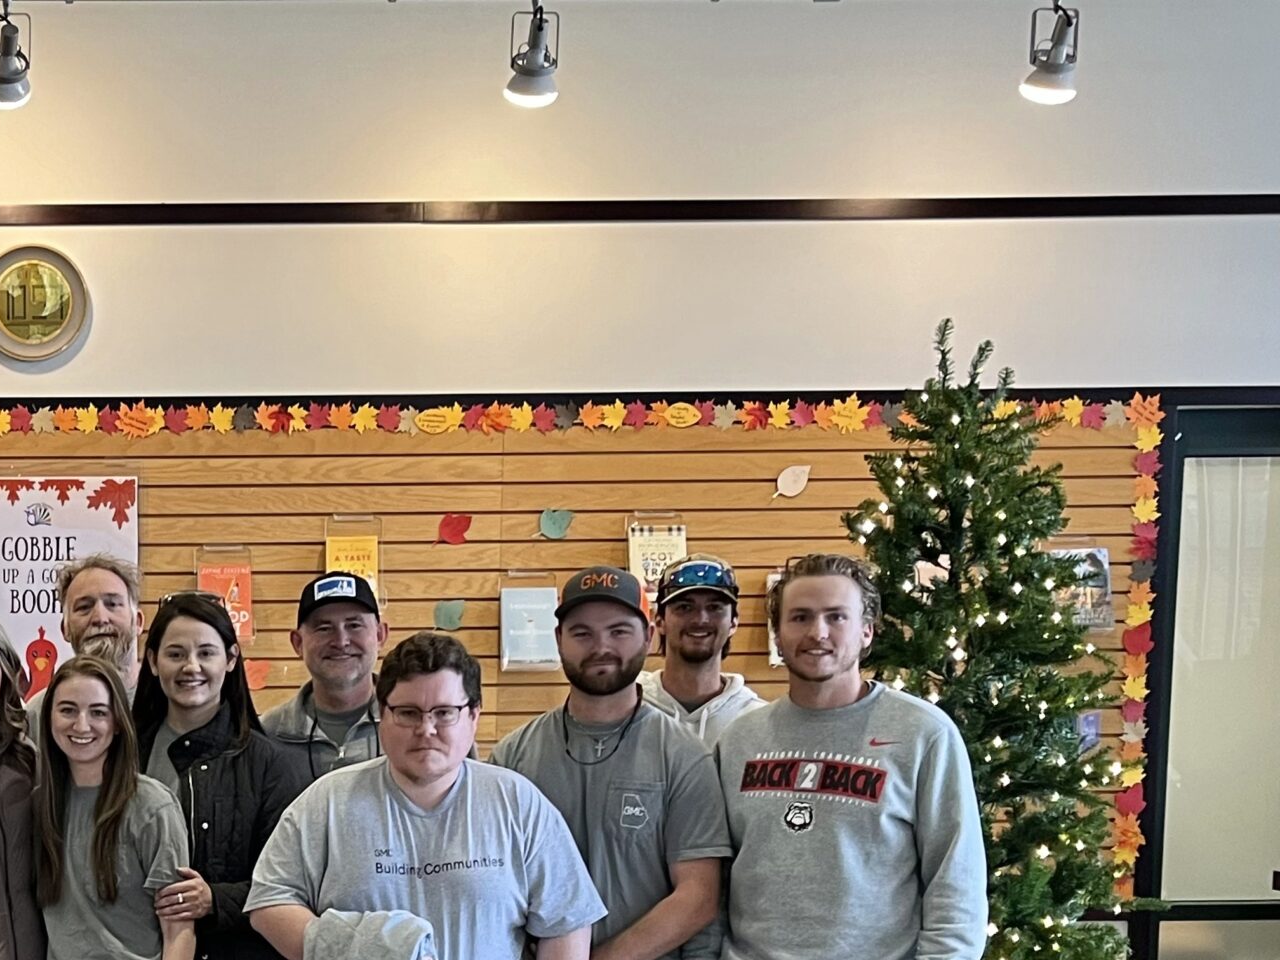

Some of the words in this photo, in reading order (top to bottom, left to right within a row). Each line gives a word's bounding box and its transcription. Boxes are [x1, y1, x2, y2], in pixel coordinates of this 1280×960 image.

[1, 536, 77, 561] GOBBLE
[642, 552, 675, 561] SCOT
[345, 554, 371, 562] TASTE
[2, 568, 19, 584] UP
[27, 568, 35, 584] A
[42, 568, 60, 584] GO
[580, 573, 619, 590] GMC
[742, 761, 797, 790] BACK
[800, 763, 816, 788] 2
[821, 764, 882, 800] BACK
[375, 862, 423, 880] Building
[423, 856, 505, 876] Communities
